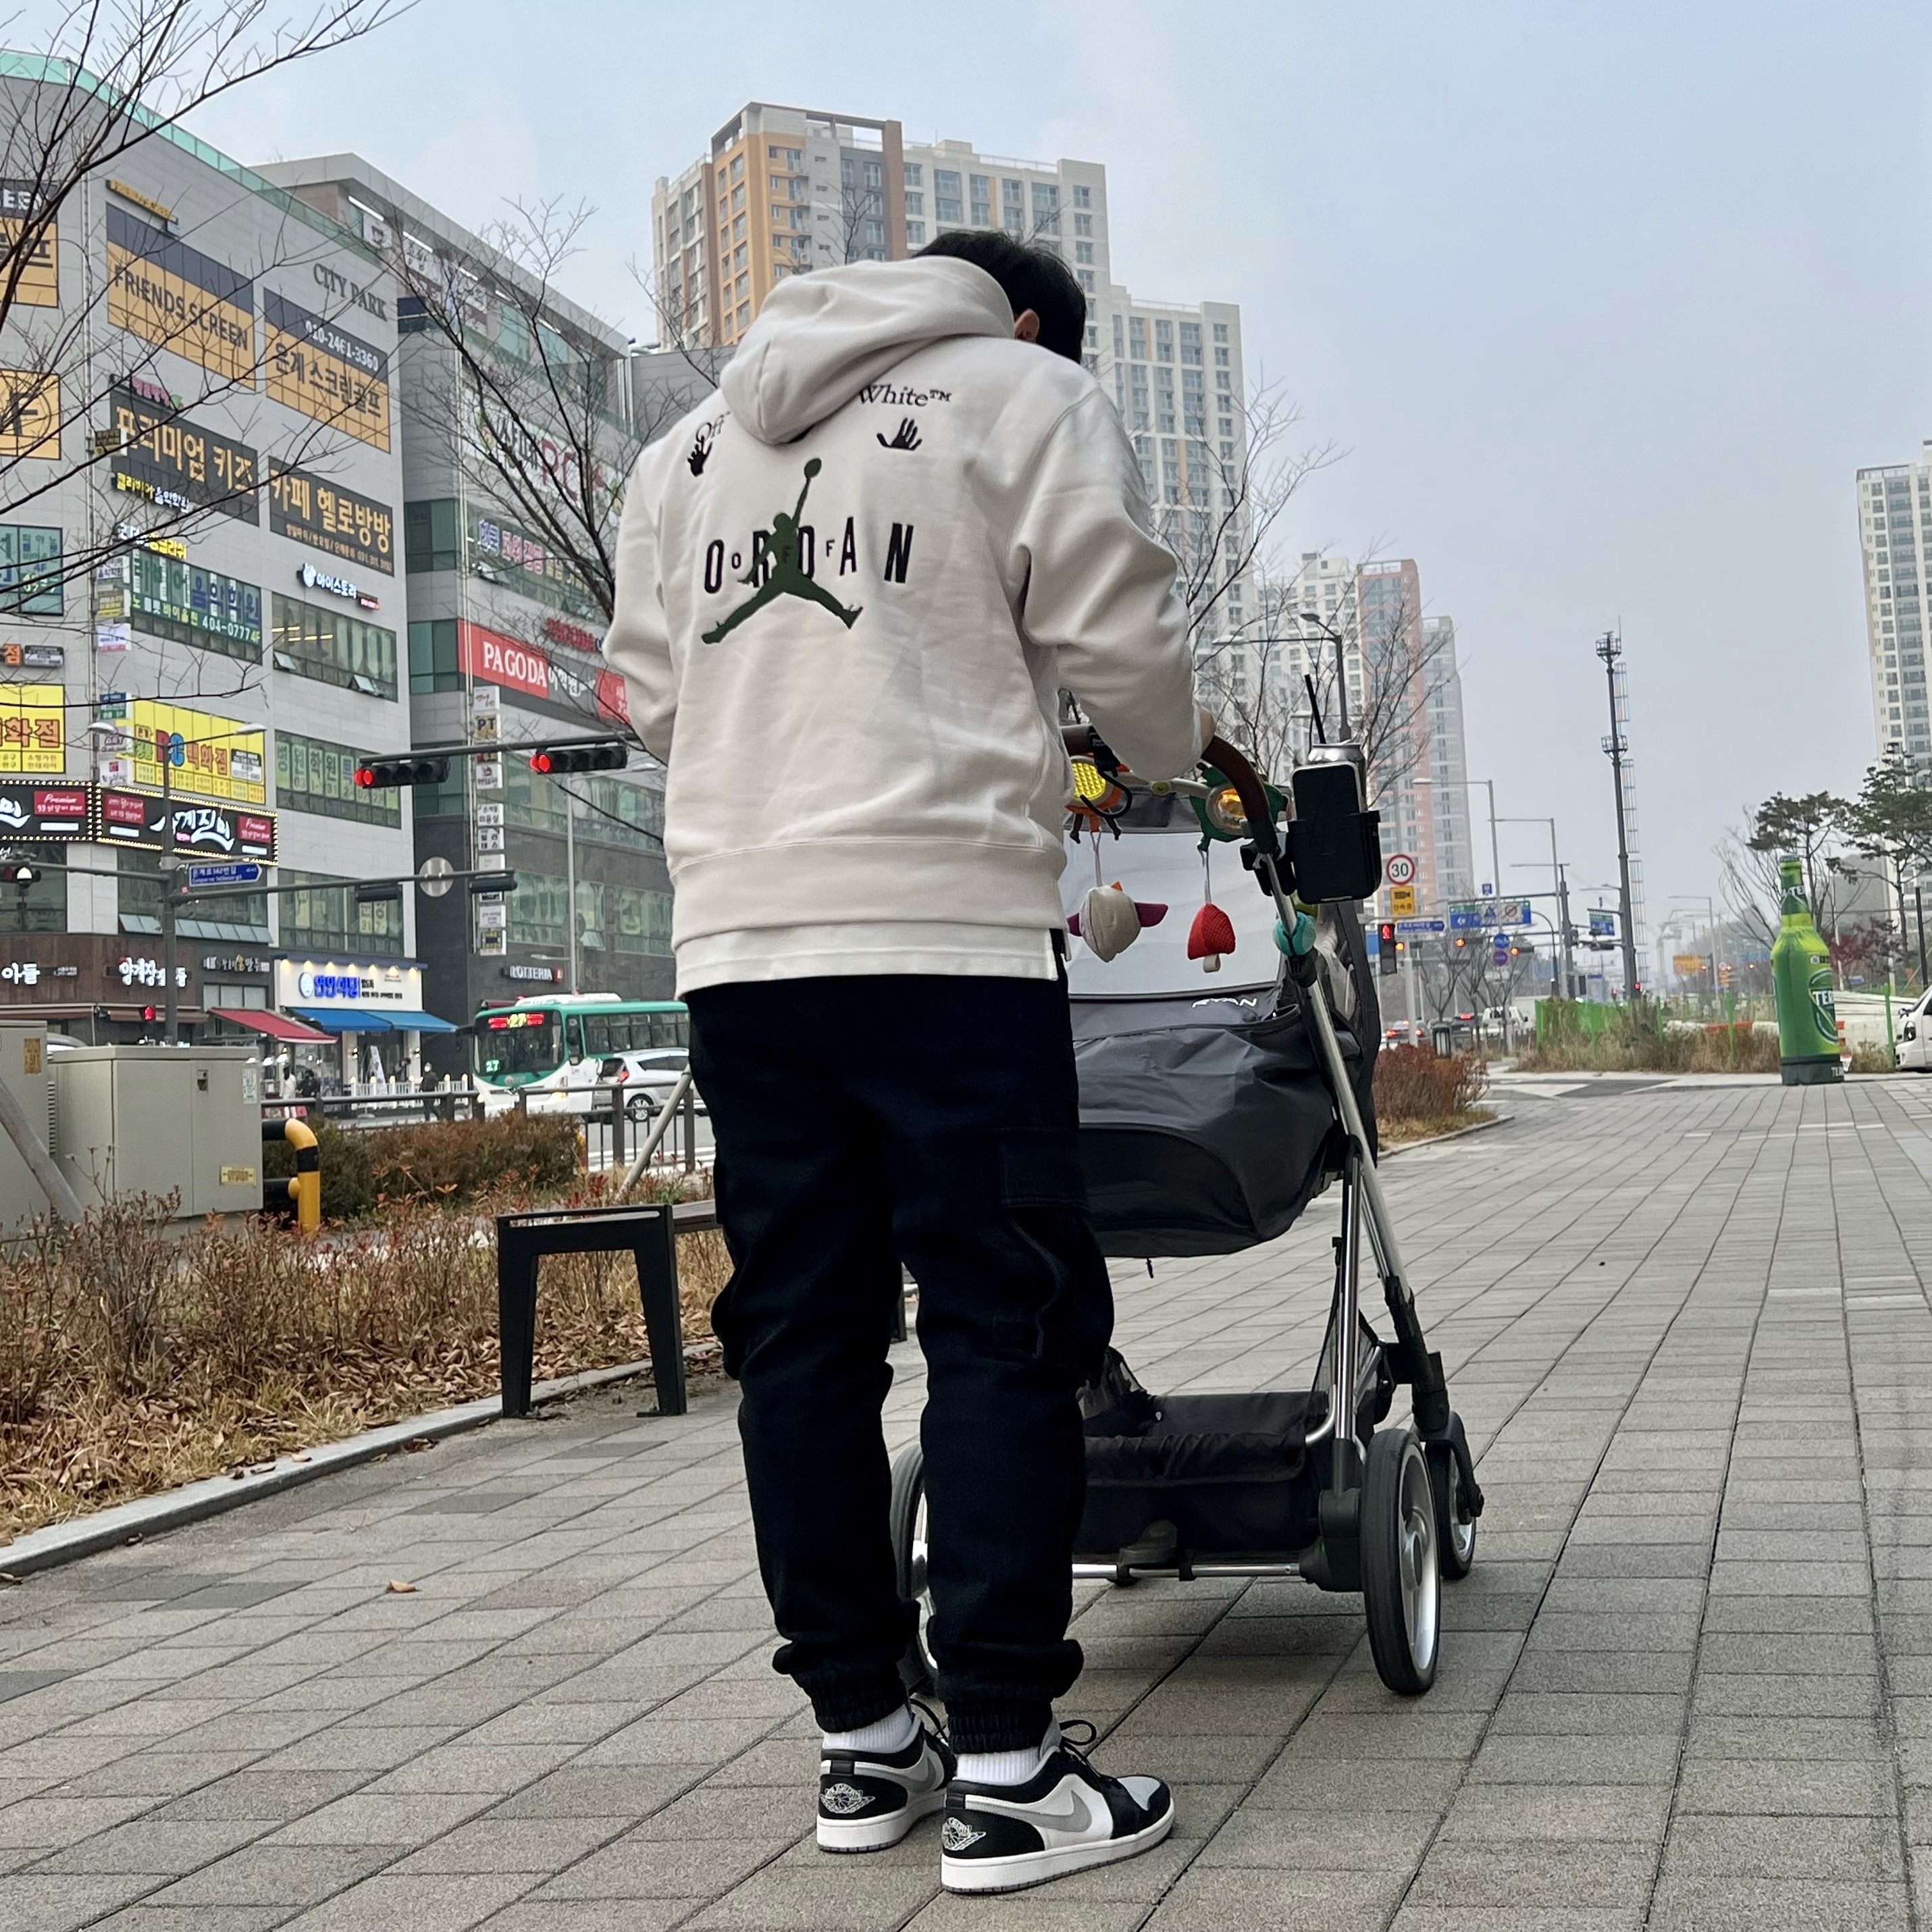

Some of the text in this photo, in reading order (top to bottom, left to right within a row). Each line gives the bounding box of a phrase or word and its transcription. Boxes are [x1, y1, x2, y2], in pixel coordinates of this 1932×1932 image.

[313, 263, 347, 298] CITY
[350, 281, 388, 322] PARK
[114, 264, 248, 351] FRIENDS SCREEN
[213, 446, 255, 496] 키즈
[270, 469, 391, 554] 카페 헬로방방
[317, 573, 357, 599] 아이스토리
[203, 615, 251, 641] 404-0777
[483, 641, 548, 688] PAGODA
[0, 717, 60, 748] 화점
[478, 718, 496, 731] PT
[1392, 864, 1409, 877] 30
[1, 962, 40, 985] 아들
[510, 965, 553, 981] LOTTERIA
[509, 1013, 527, 1028] 27
[486, 1060, 499, 1072] 27
